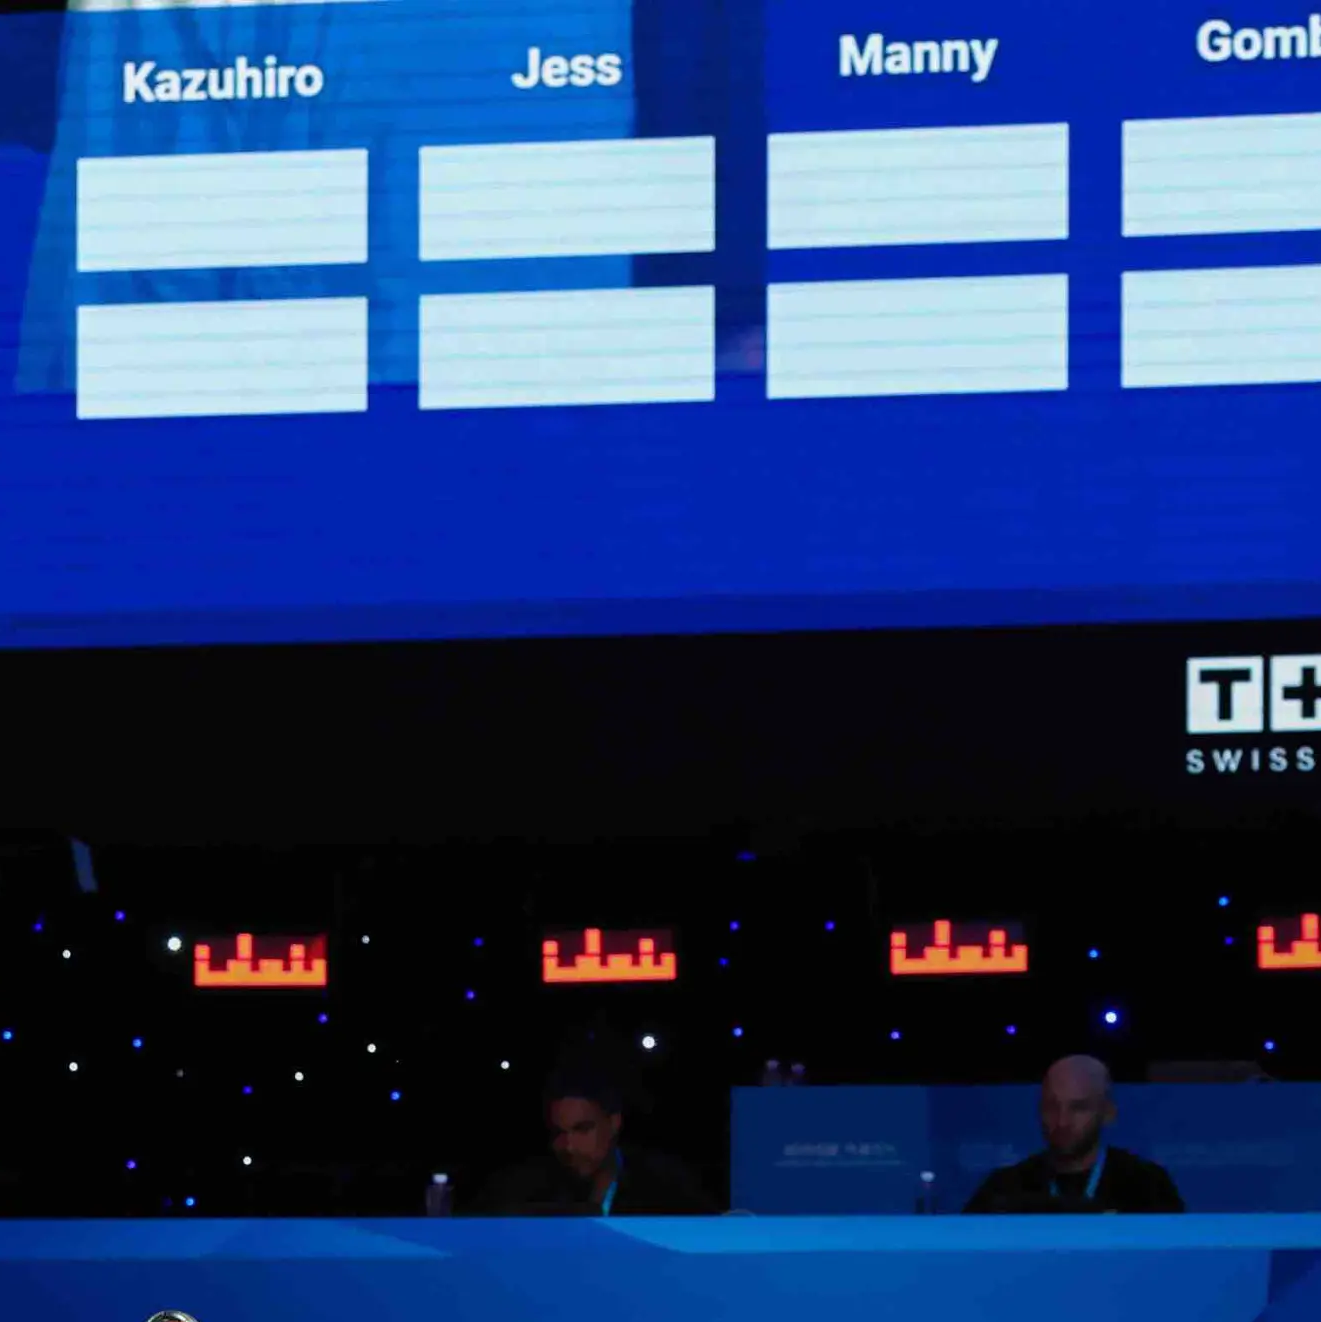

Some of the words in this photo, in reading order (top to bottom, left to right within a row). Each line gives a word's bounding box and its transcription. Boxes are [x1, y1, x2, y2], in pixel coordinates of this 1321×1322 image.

[513, 48, 621, 87] Jess
[841, 34, 997, 81] Manny
[125, 56, 322, 102] Kazuhiro
[1187, 747, 1315, 772] SWISS
